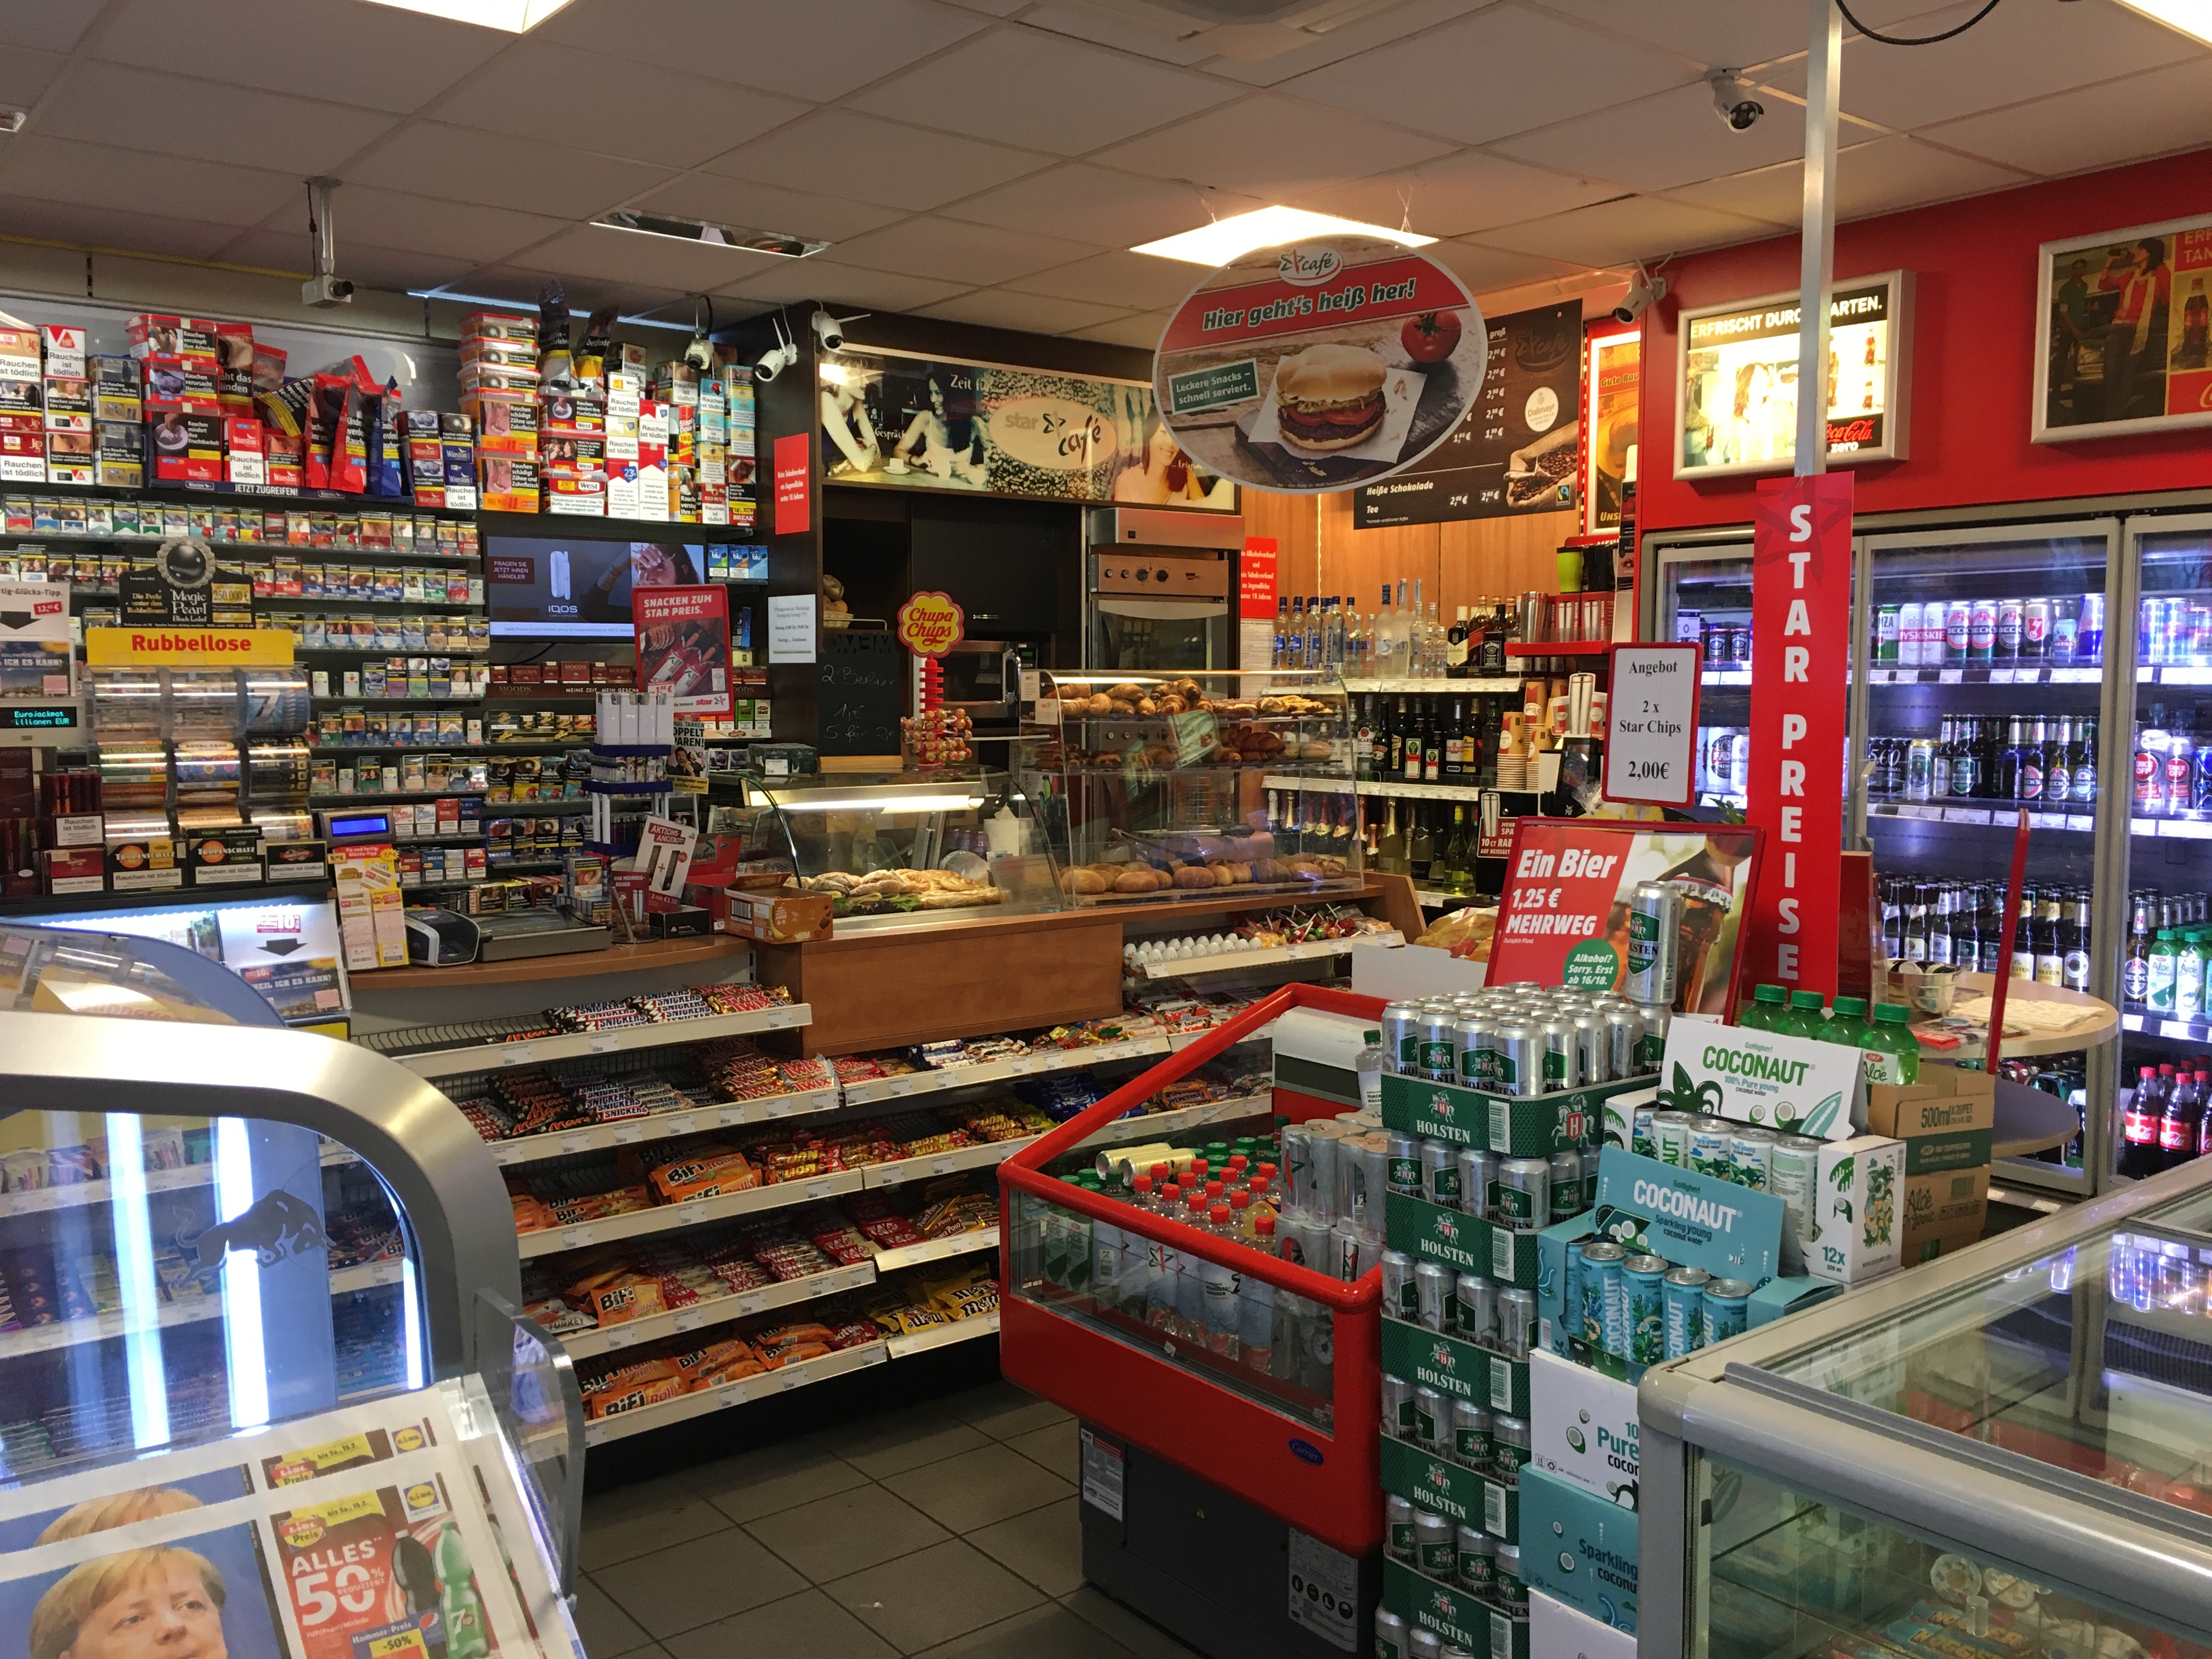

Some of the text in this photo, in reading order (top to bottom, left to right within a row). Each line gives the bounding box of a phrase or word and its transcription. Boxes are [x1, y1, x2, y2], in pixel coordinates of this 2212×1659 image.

[1301, 252, 1333, 275] café
[1203, 278, 1417, 331] Hier geht's heiß her!
[1691, 296, 1882, 338] ERFRISCHT DURC ARTEN.
[1489, 328, 1506, 339] groß
[0, 359, 37, 369] Rauchen
[49, 352, 84, 362] Rauchen
[10, 368, 40, 377] tödlich
[53, 368, 80, 376] tödlich
[950, 375, 972, 390] Zeit
[1176, 373, 1242, 392] Leckere Snacks
[1601, 376, 1621, 387] Gute
[1179, 383, 1251, 404] schnell serviert.
[1527, 403, 1555, 417] Dallmayr
[1005, 412, 1039, 430] star
[1831, 442, 1859, 453] zero
[4, 460, 42, 469] Rauchen
[14, 469, 44, 478] tödlich
[235, 471, 260, 479] tödlich
[235, 484, 298, 495] JETZT ZUGREIFEN!
[1367, 481, 1434, 496] Heiße Schokolade
[1367, 506, 1379, 514] Tee
[172, 589, 206, 606] Magic
[644, 594, 712, 608] SNACKEN ZUM
[172, 602, 207, 614] Pearl
[549, 605, 578, 613] IQOS
[645, 606, 703, 618] STAR PREIS.
[909, 607, 954, 626] Chupa
[132, 634, 251, 651] Rubbellose
[907, 622, 952, 646] Chups
[1628, 661, 1678, 677] Angebot
[1642, 701, 1660, 713] 2 x
[1620, 720, 1681, 737] Star Chips
[1628, 760, 1670, 781] 2,00€
[1516, 849, 1618, 878] Ein Bier
[1512, 888, 1562, 911] 1,25 €
[1505, 915, 1597, 935] MEHRWEG
[1573, 953, 1613, 964] Alkohol?
[1568, 964, 1614, 975] Sorry. Erst
[1567, 975, 1607, 985] ab 16/18.
[599, 1014, 647, 1028] SNICKERS
[1703, 1046, 1809, 1086] COCONAUT
[1724, 1075, 1779, 1094] 100% Pure young
[1921, 1105, 1950, 1128] 500ml
[1417, 1119, 1470, 1144] HOLSTEN
[1634, 1180, 1736, 1233] COCONAUT
[1655, 1214, 1712, 1242] Sparkling young
[1663, 1228, 1703, 1246] coconut water
[1420, 1238, 1474, 1267] HOLSTEN
[1822, 1246, 1846, 1266] 12x
[1418, 1367, 1471, 1397] HOLSTEN
[1292, 1442, 1320, 1463] Carrier
[1597, 1426, 1639, 1462] Pure
[1414, 1486, 1466, 1520] HOLSTEN
[294, 1530, 318, 1543] Preis
[292, 1540, 375, 1576] ALLES
[1579, 1538, 1638, 1580] Sparkling
[295, 1565, 375, 1627] 50
[1419, 1610, 1472, 1647] HOLSTEN
